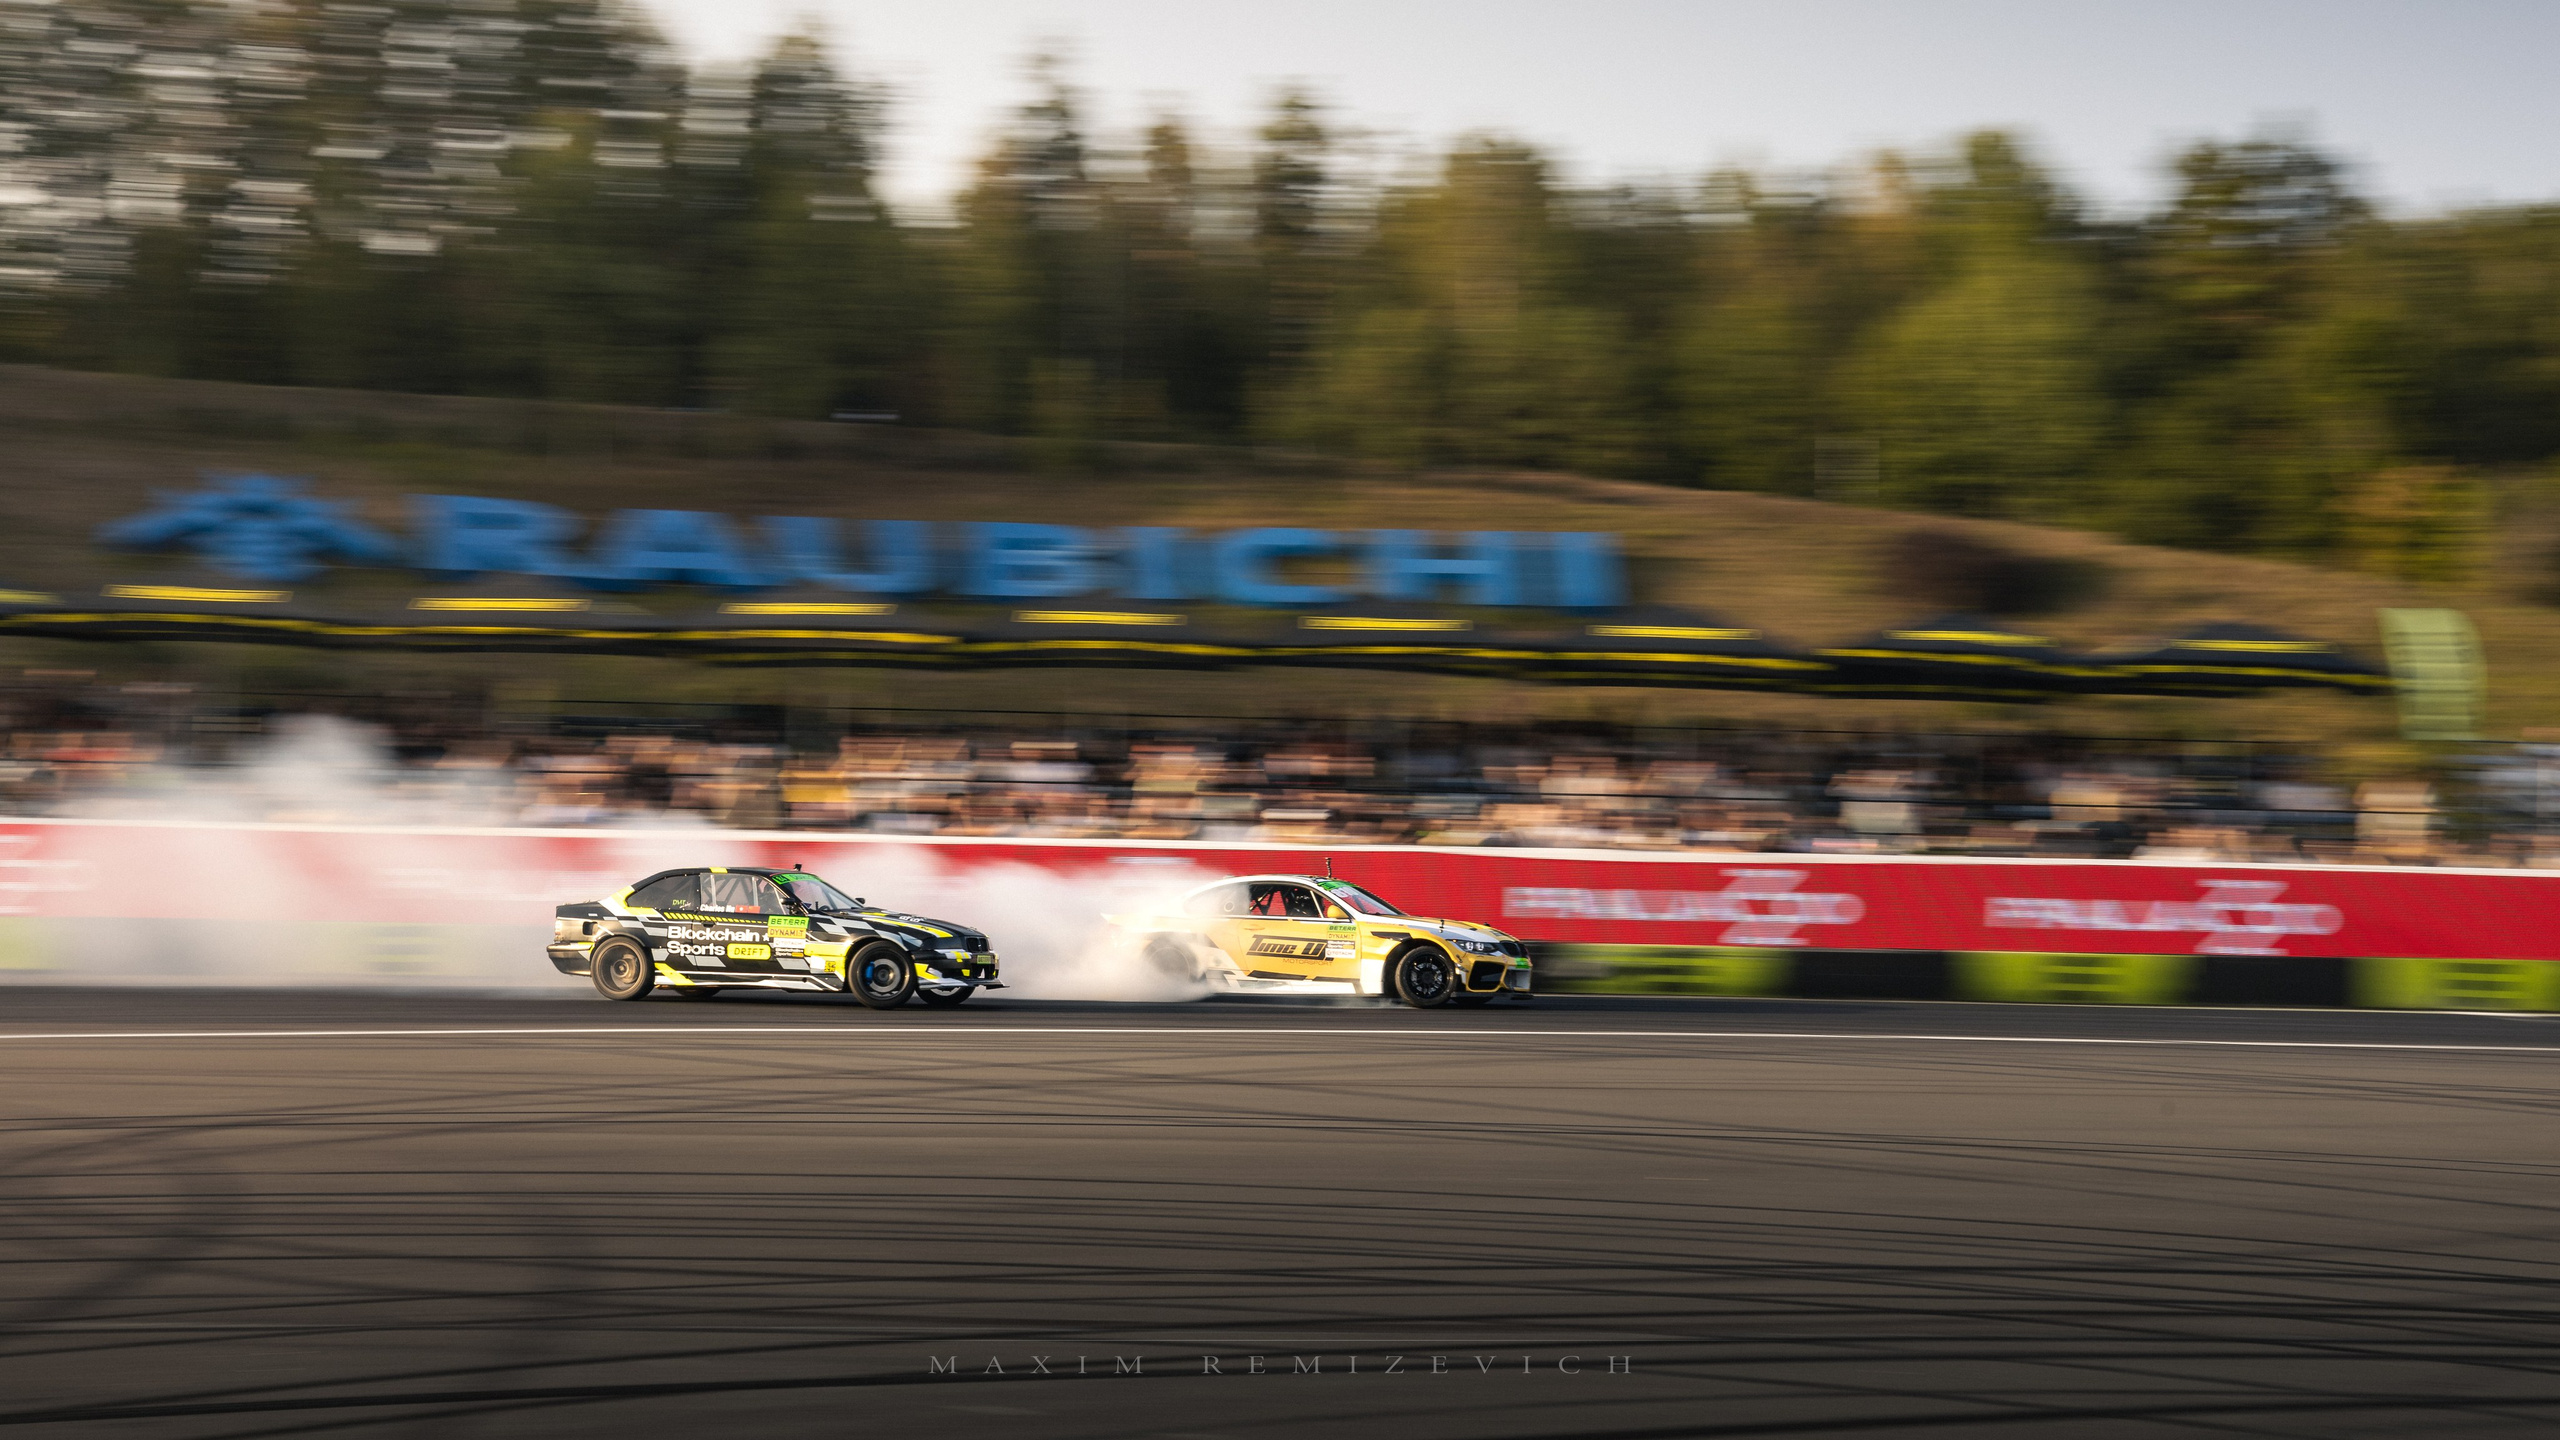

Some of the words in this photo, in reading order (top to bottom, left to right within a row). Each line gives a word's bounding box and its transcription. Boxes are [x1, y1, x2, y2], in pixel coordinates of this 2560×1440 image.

[667, 926, 760, 942] Blockchain
[667, 940, 726, 957] Sports
[734, 947, 765, 956] DRIFT
